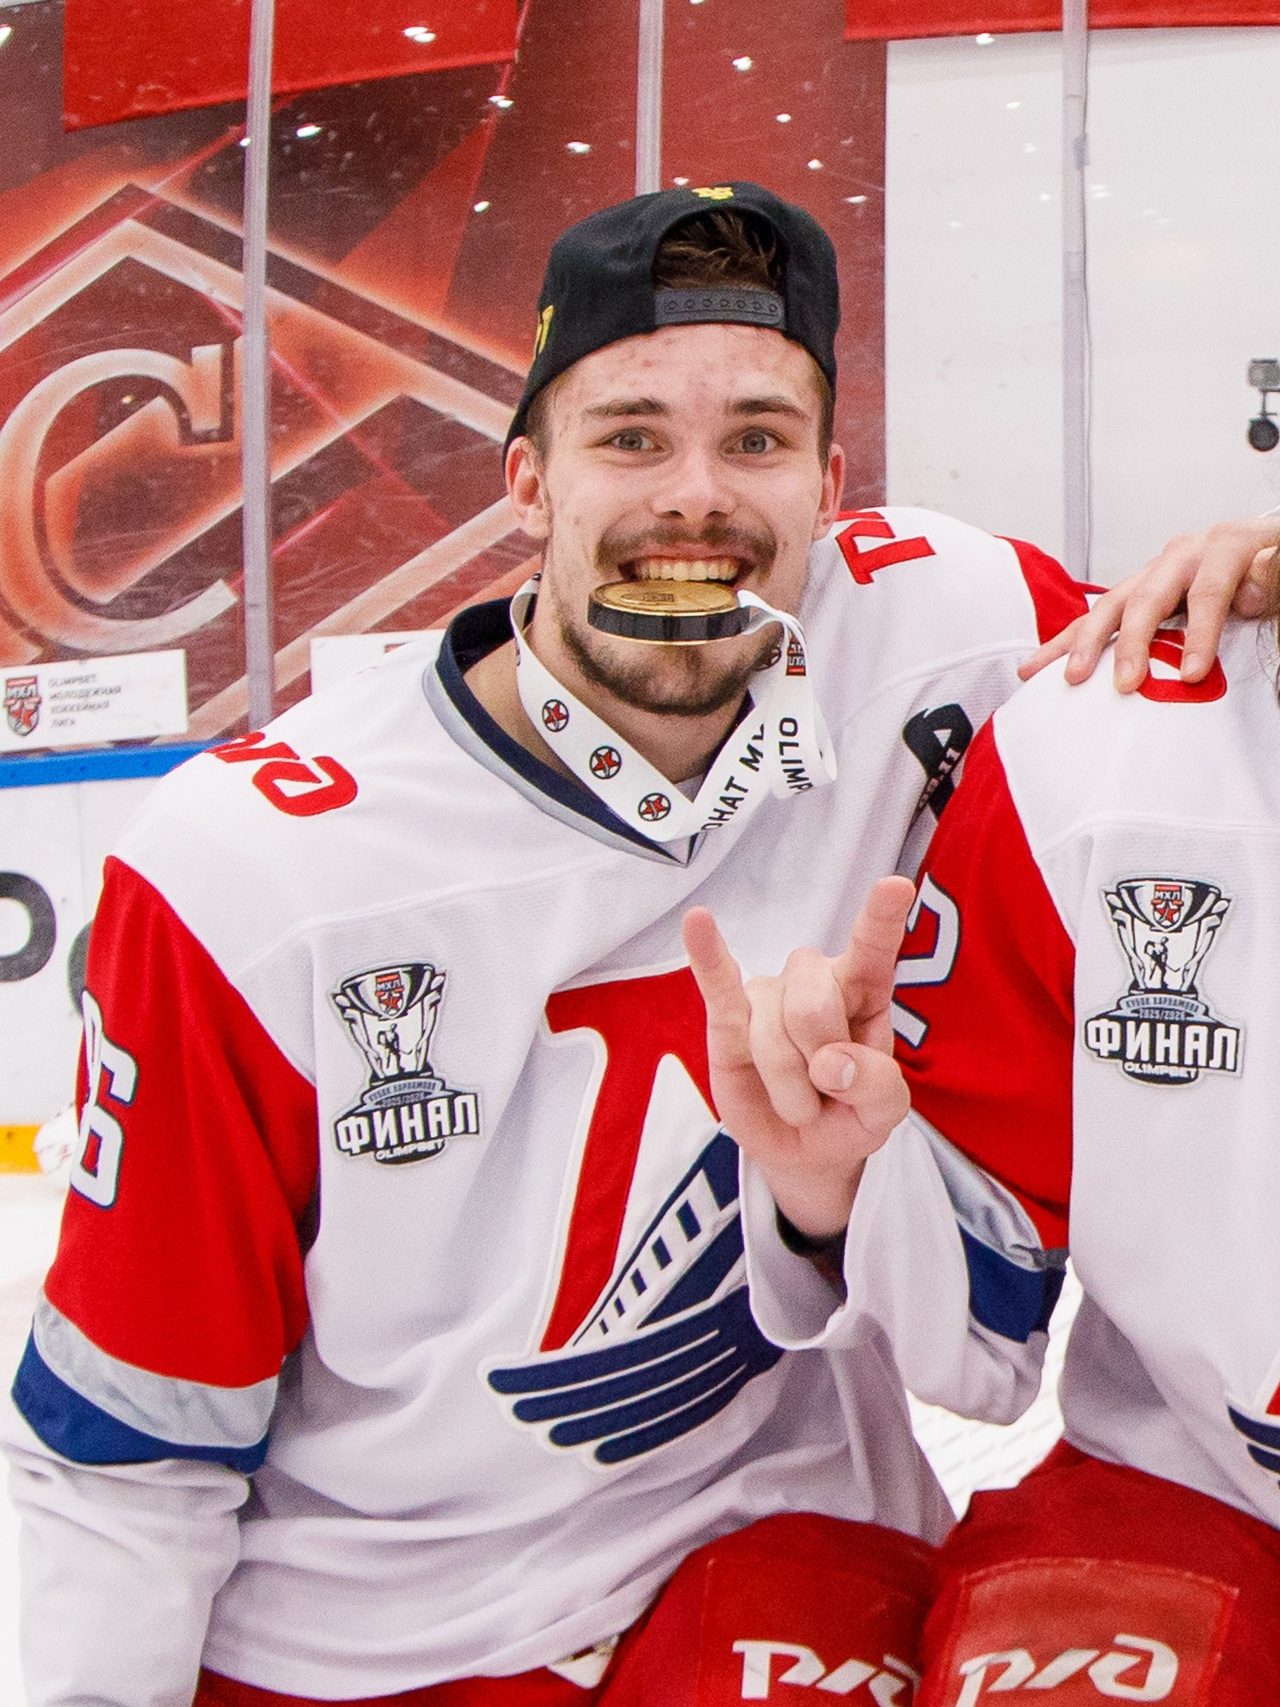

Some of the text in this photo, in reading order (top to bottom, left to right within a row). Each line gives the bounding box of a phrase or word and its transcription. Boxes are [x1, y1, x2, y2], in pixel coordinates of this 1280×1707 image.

[1154, 890, 1182, 899] МХЛ
[1086, 1017, 1239, 1072] ФИНАЛ
[336, 1094, 479, 1155] ФИНАЛ
